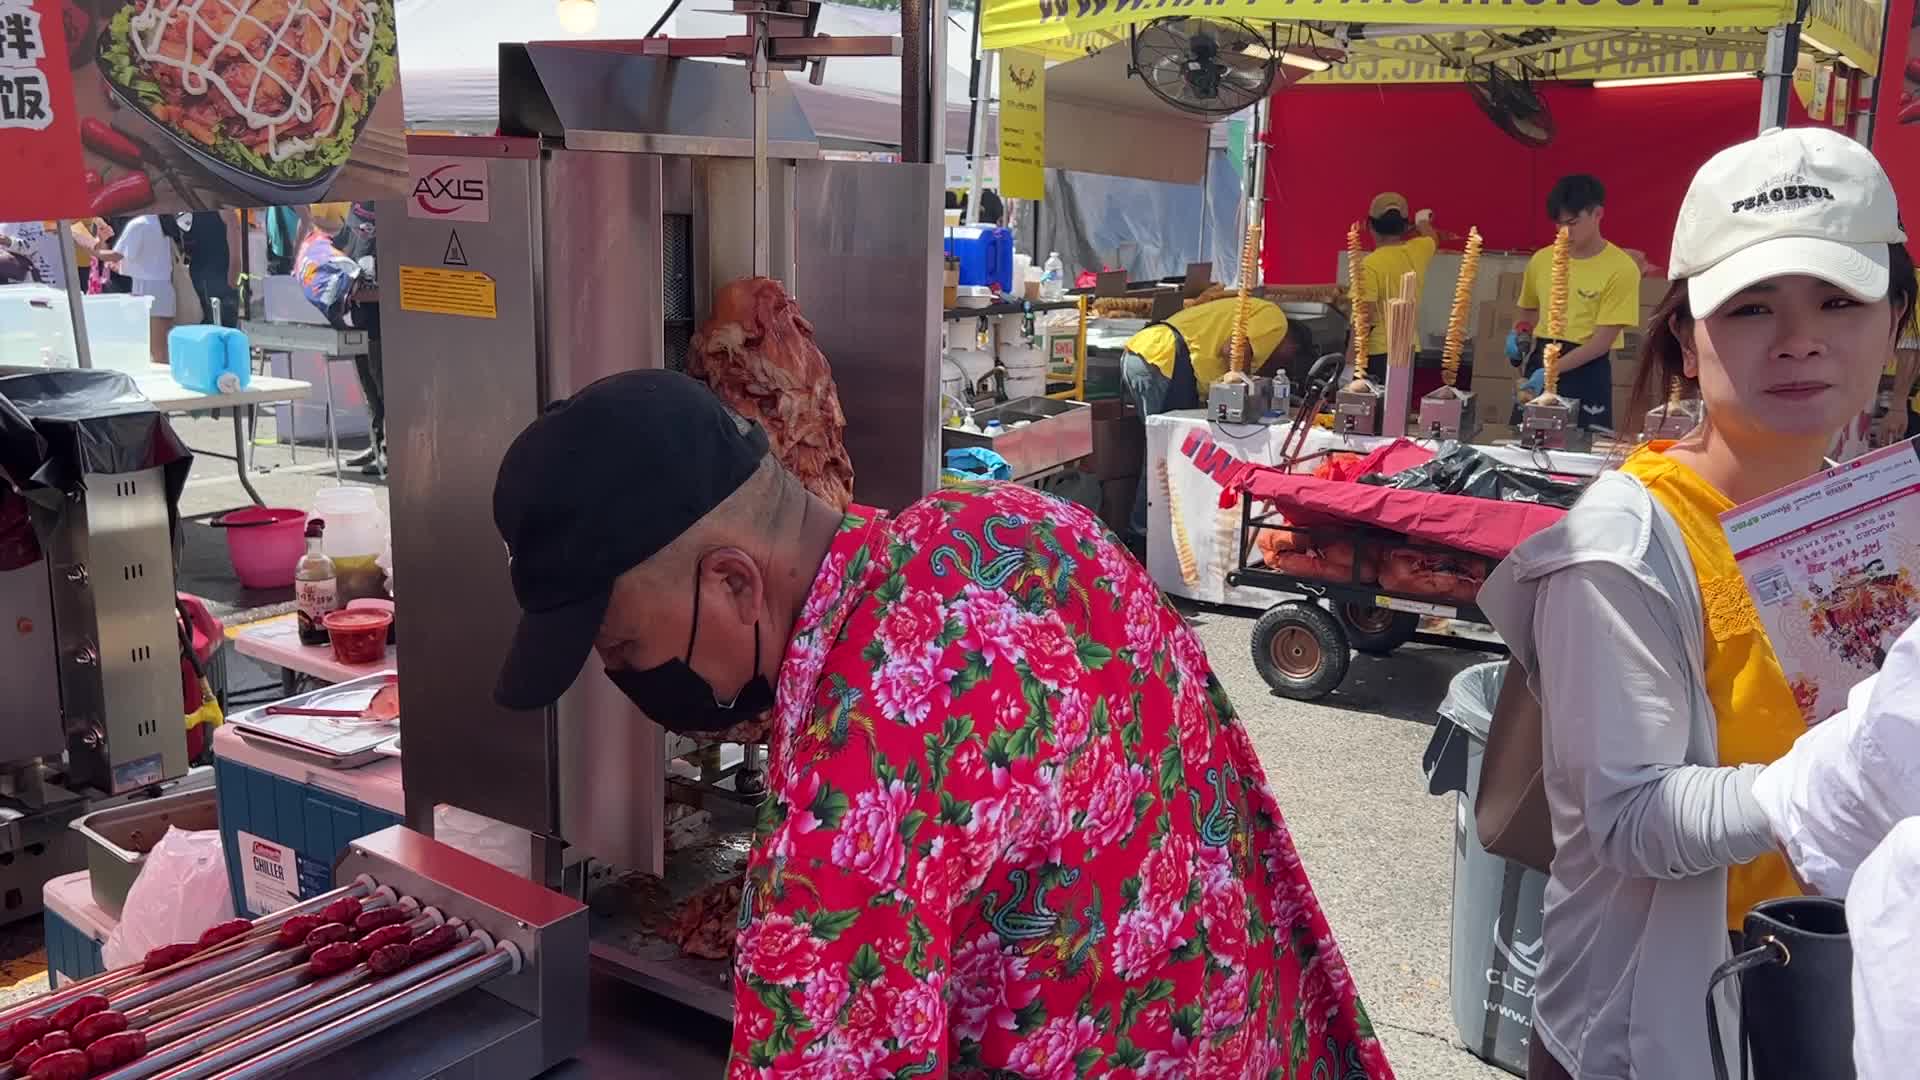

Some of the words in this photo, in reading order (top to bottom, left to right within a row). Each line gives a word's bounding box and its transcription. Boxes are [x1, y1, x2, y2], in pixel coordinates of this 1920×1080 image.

[413, 177, 484, 201] AXIS
[1731, 185, 1836, 213] PEACEFUL
[253, 856, 285, 881] CHILLER
